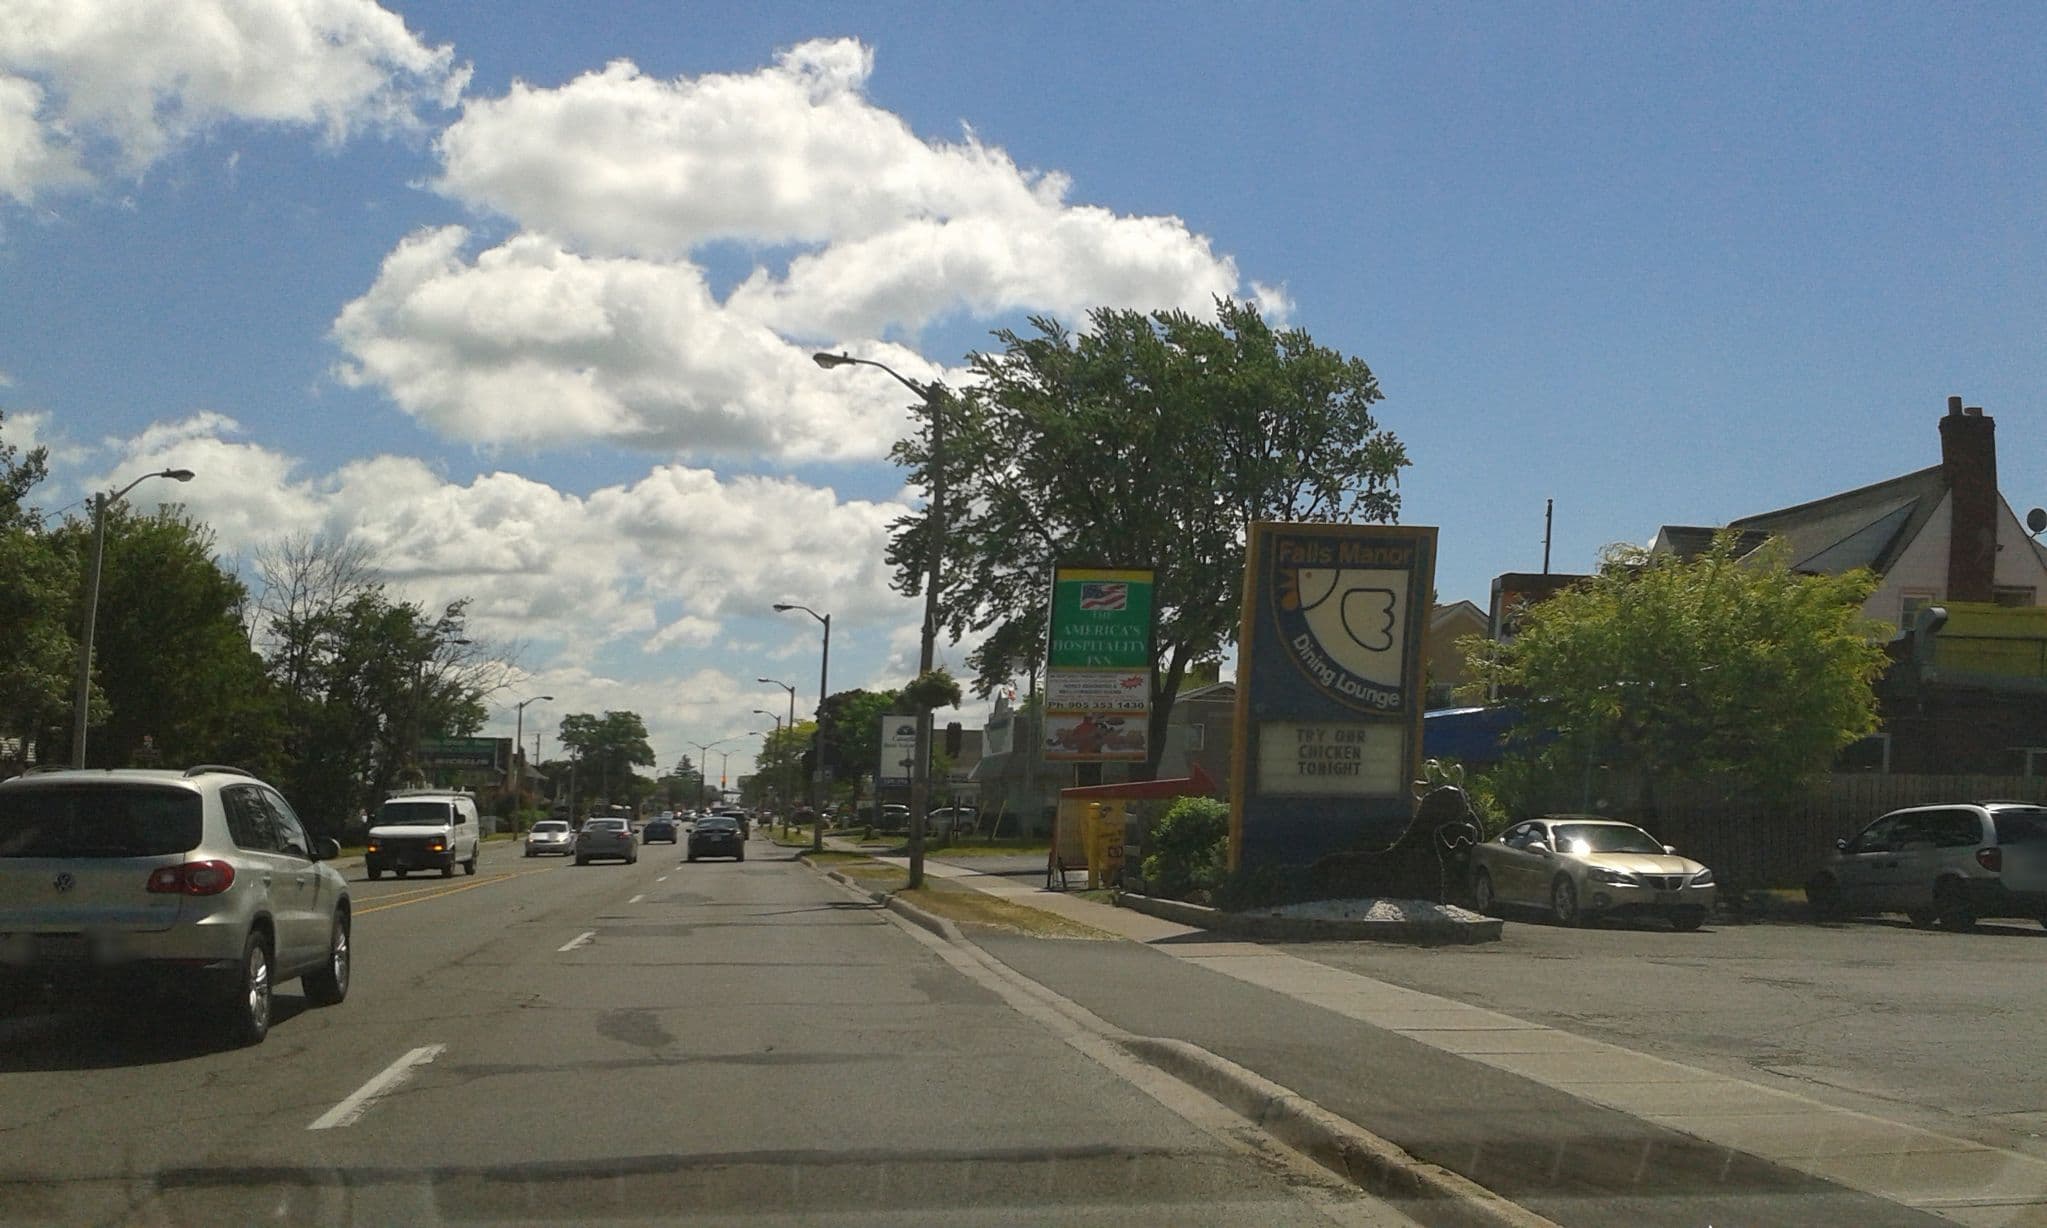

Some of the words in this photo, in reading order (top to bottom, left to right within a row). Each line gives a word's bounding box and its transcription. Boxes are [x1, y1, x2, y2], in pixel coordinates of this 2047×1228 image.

[1279, 542, 1330, 563] Falls
[1339, 543, 1415, 564] Manor
[1063, 624, 1141, 636] AMERICA'S
[1053, 640, 1145, 652] HOSPITALITY
[1088, 655, 1113, 665] INN
[1293, 632, 1337, 687] Dining
[1335, 672, 1400, 708] Lounge
[1069, 701, 1089, 709] 905
[1117, 701, 1144, 709] 1430
[1296, 728, 1325, 743] TRY
[1335, 729, 1365, 743] OUR
[1299, 745, 1361, 759] CHICKEN
[1298, 761, 1361, 775] TONIGHT
